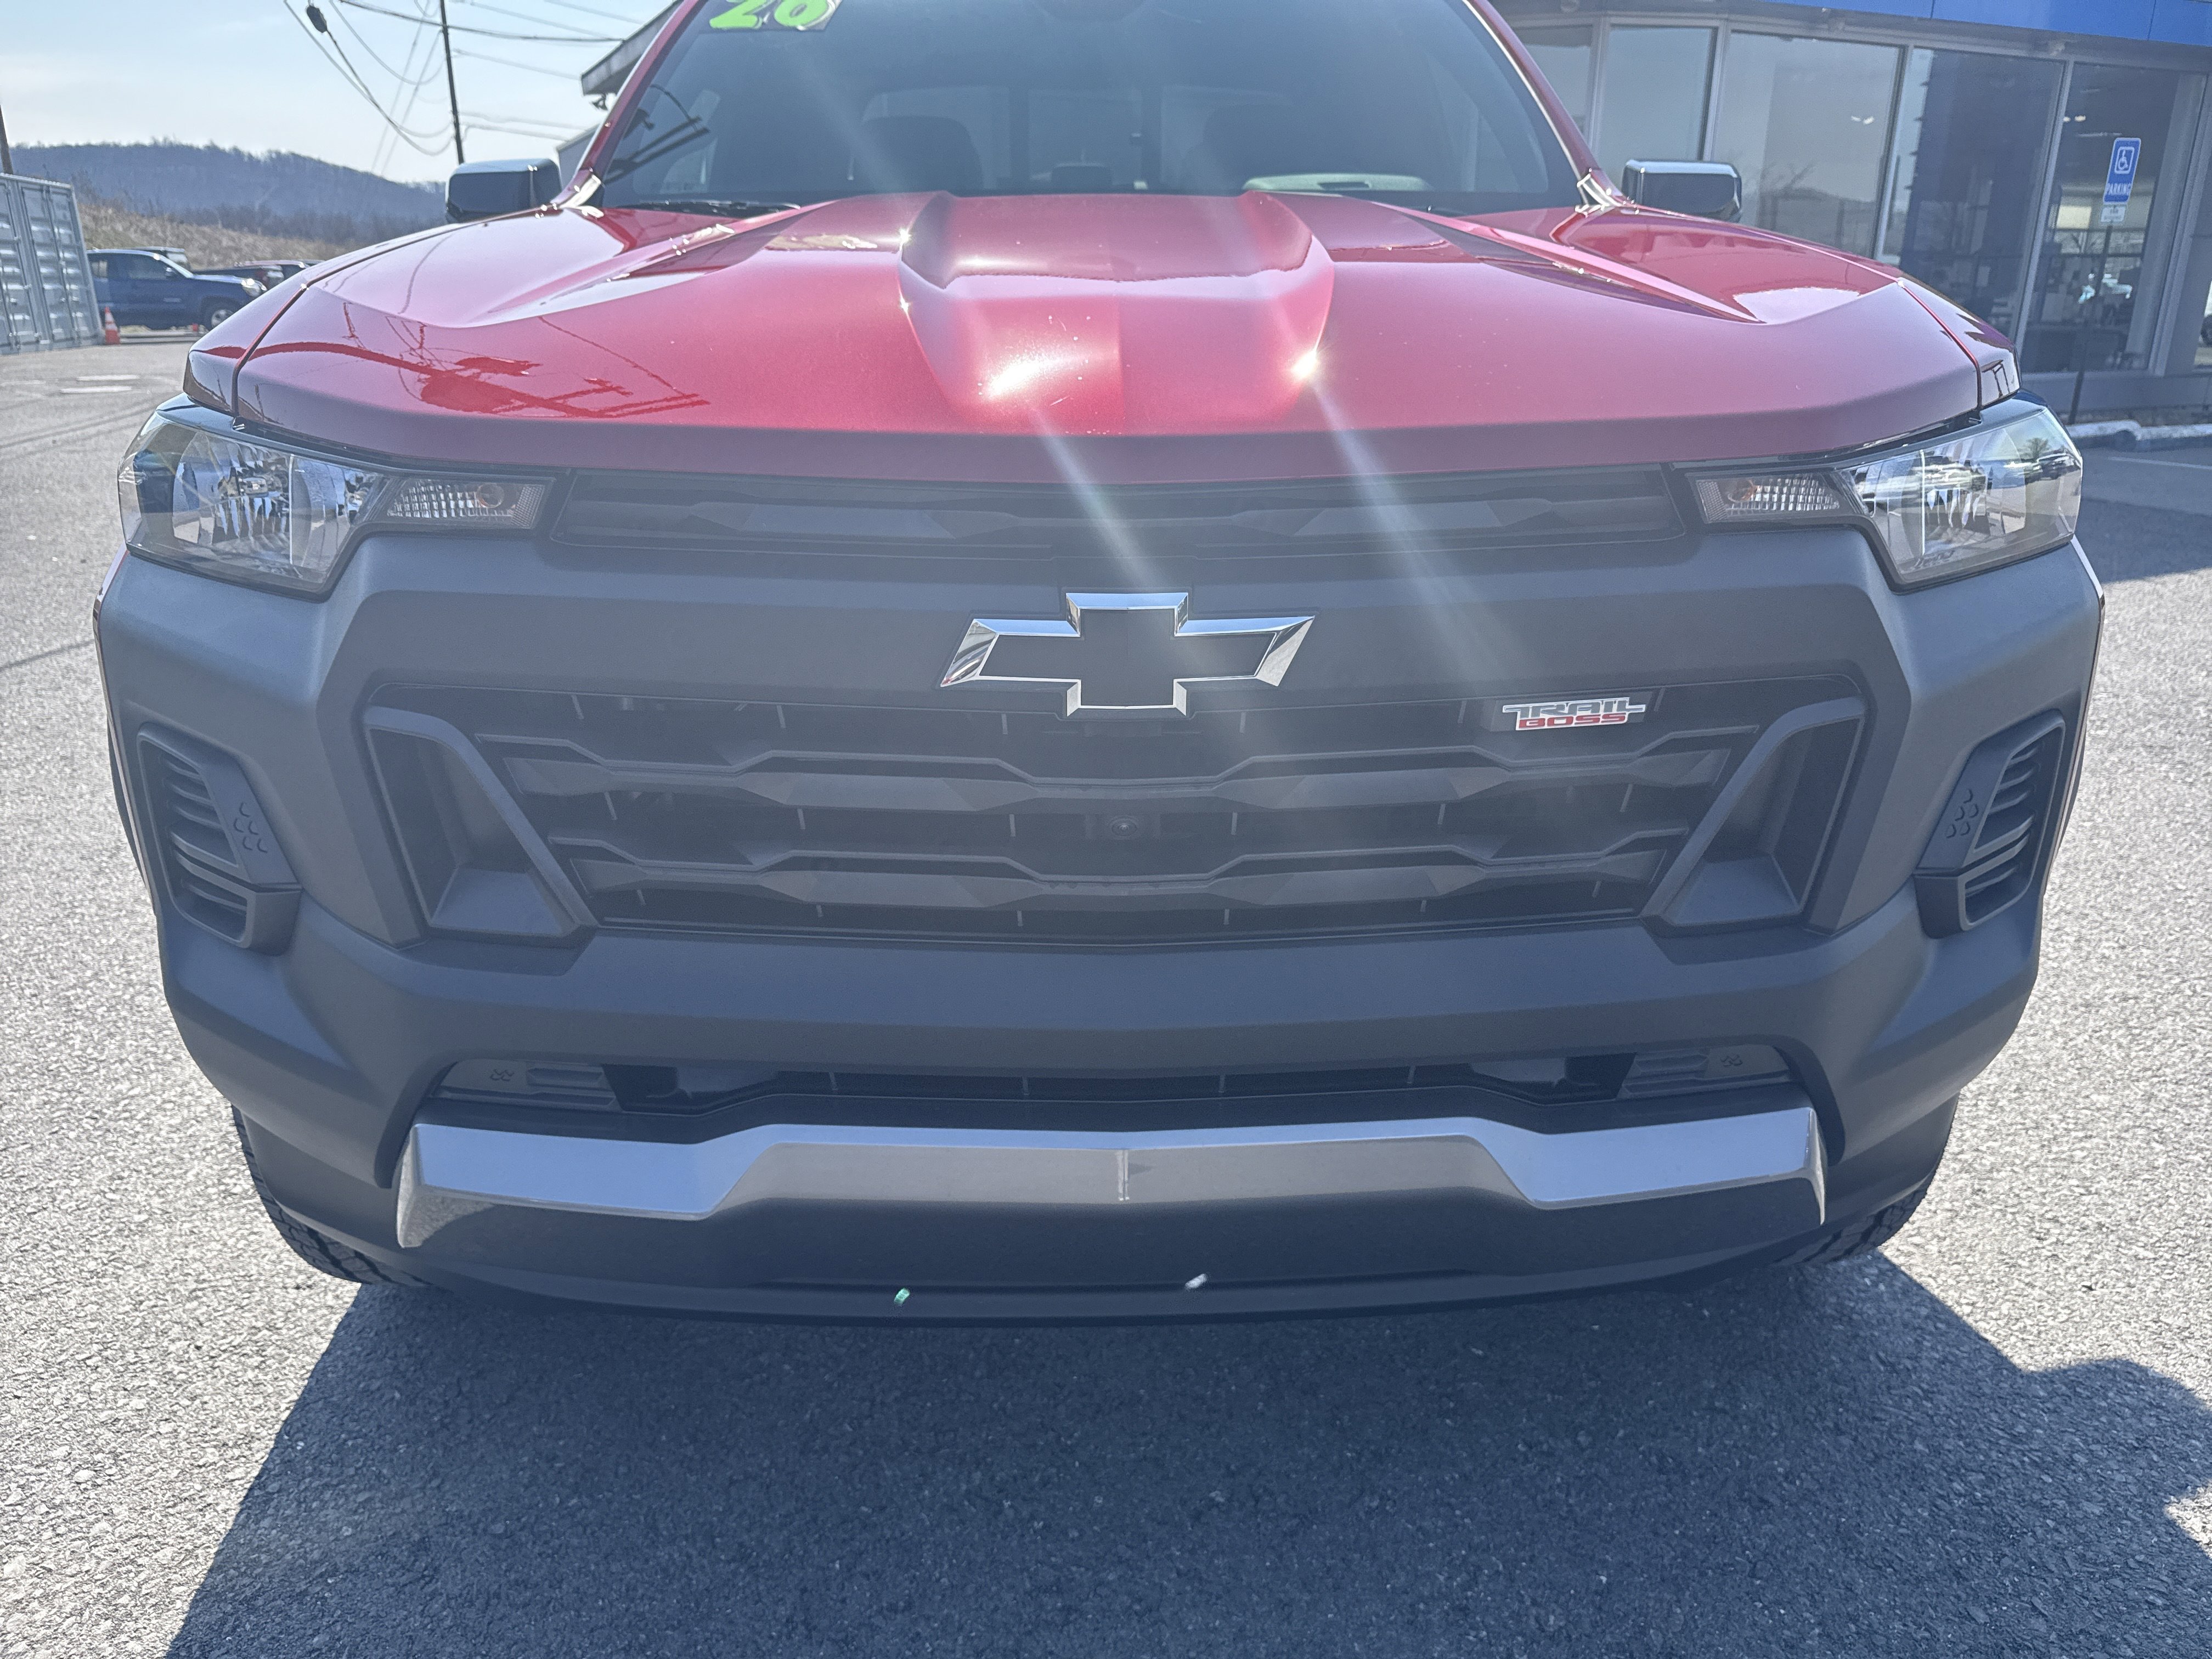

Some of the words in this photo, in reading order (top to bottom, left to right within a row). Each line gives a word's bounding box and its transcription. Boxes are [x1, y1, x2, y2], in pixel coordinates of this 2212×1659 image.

[2105, 183, 2132, 195] PARKING
[1503, 697, 1646, 718] TRAIL
[1517, 713, 1627, 729] BOSS
